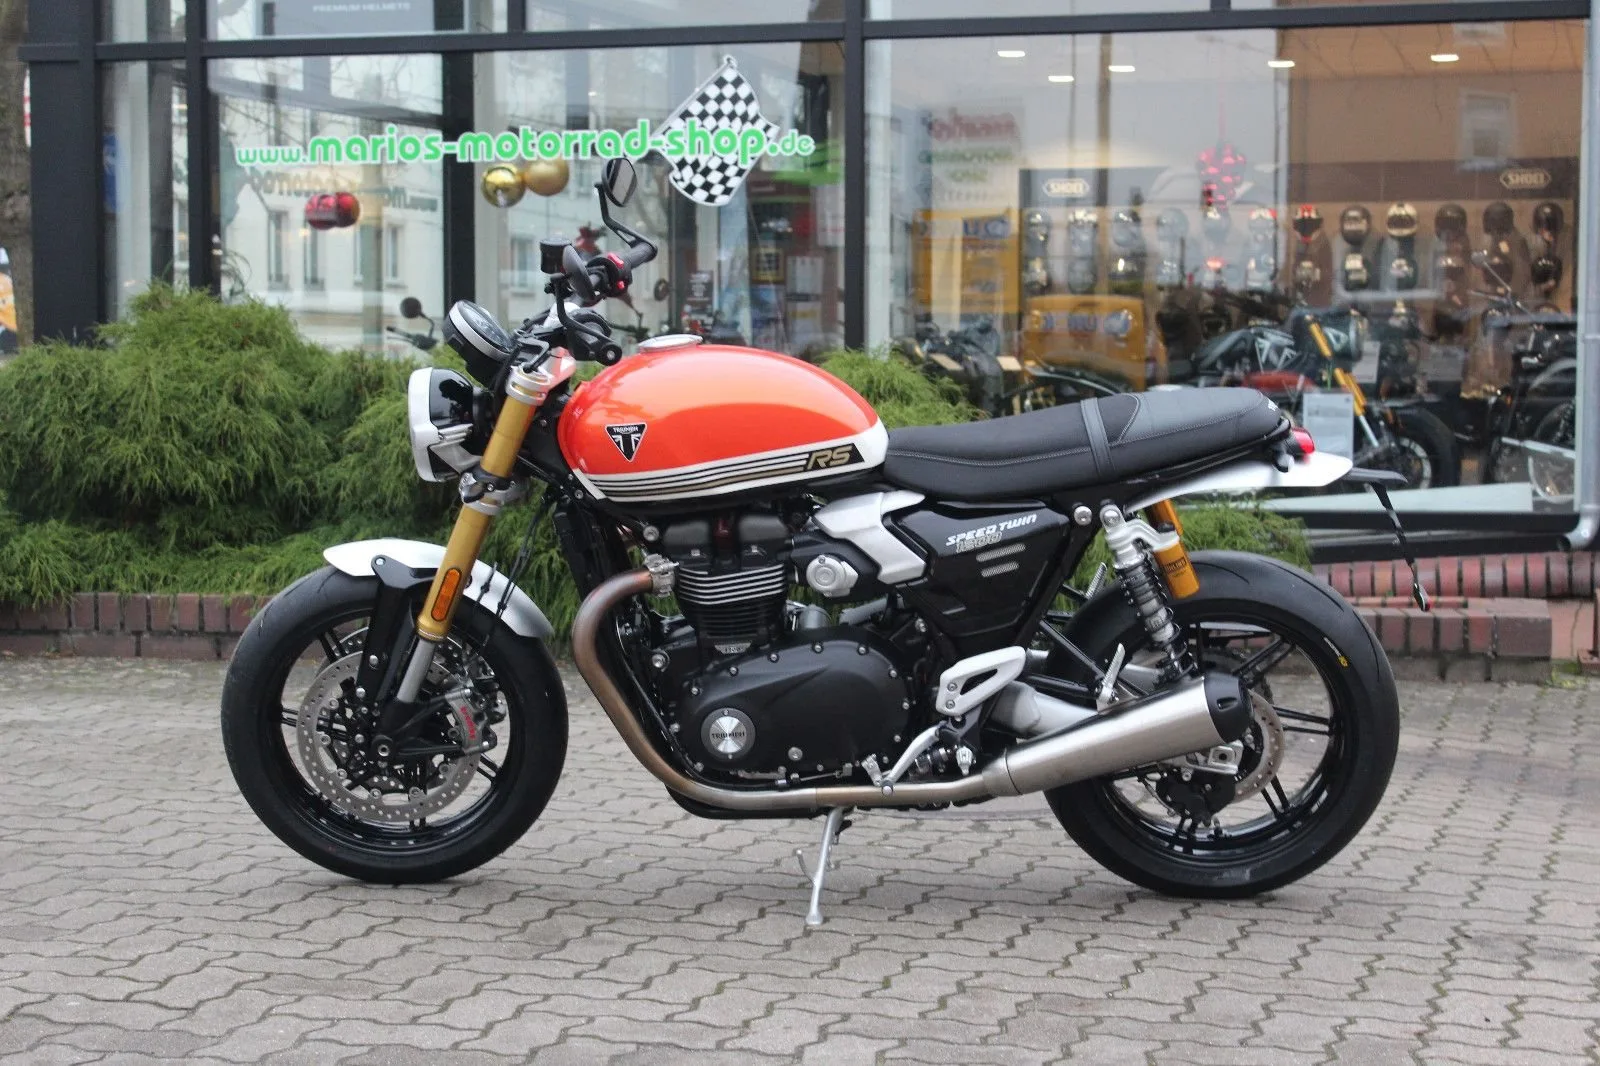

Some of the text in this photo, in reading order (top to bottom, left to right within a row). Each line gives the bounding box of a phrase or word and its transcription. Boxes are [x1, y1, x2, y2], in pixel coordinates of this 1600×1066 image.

[236, 119, 815, 167] www.marios-motorrad-shop.de
[612, 425, 639, 433] TRIUMPH
[807, 445, 853, 470] RS
[946, 513, 1037, 546] SPEED TWIN
